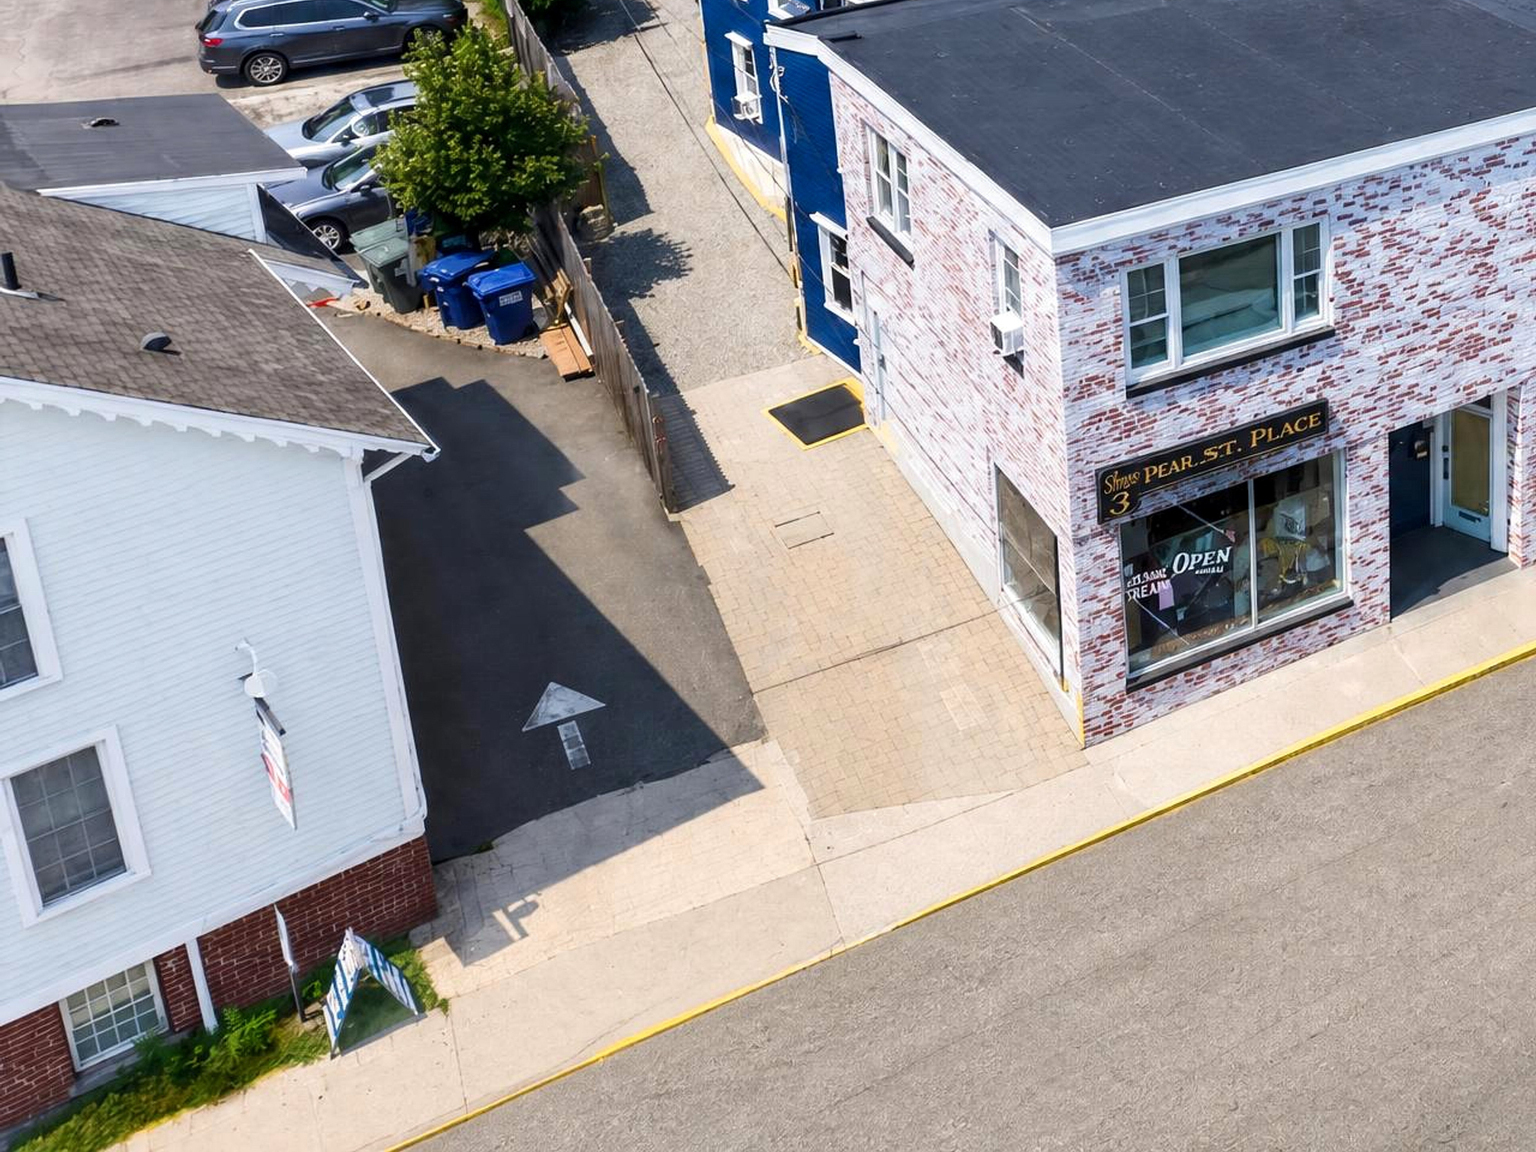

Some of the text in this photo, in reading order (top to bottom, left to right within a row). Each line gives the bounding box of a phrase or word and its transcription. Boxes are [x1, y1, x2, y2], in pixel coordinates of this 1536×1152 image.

[1204, 439, 1242, 461] ST.
[1250, 412, 1322, 448] PLACE
[1109, 491, 1131, 515] 3
[1172, 546, 1233, 575] OPEN
